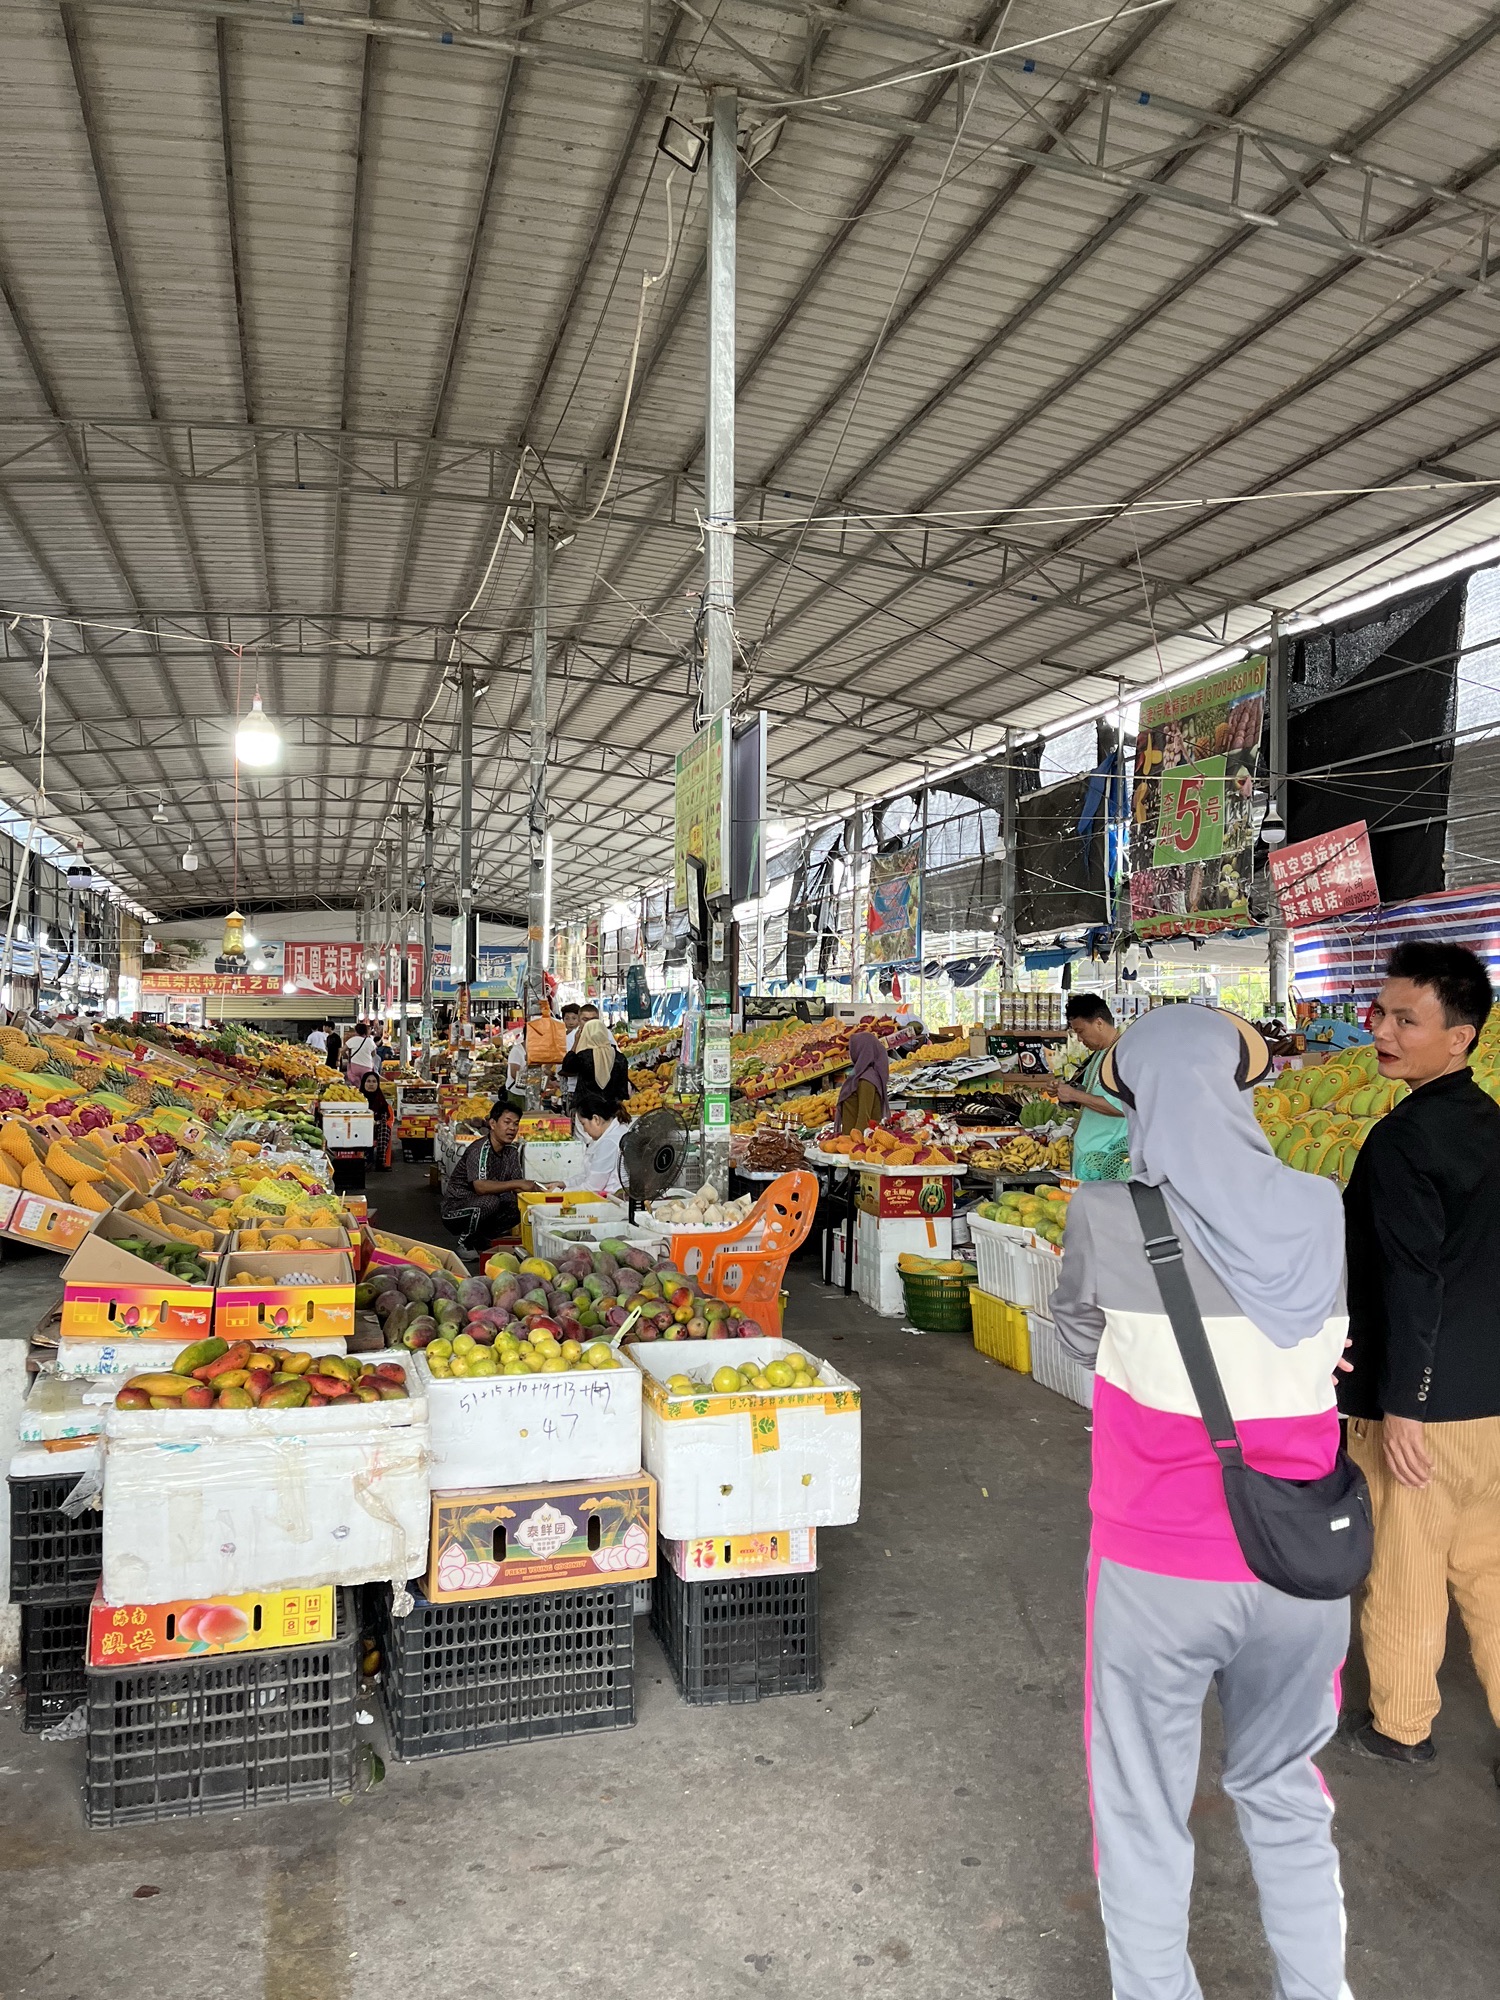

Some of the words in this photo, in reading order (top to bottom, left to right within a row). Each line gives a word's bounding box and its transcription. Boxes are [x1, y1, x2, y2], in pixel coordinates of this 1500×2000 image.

[1273, 838, 1359, 880] 航空空运打包
[142, 975, 280, 990] 凤凰荣民特产工艺品
[527, 1523, 566, 1538] 泰鲜园
[504, 1567, 528, 1577] FRESH
[527, 1564, 553, 1573] YOUNG
[553, 1560, 587, 1571] COCONUT
